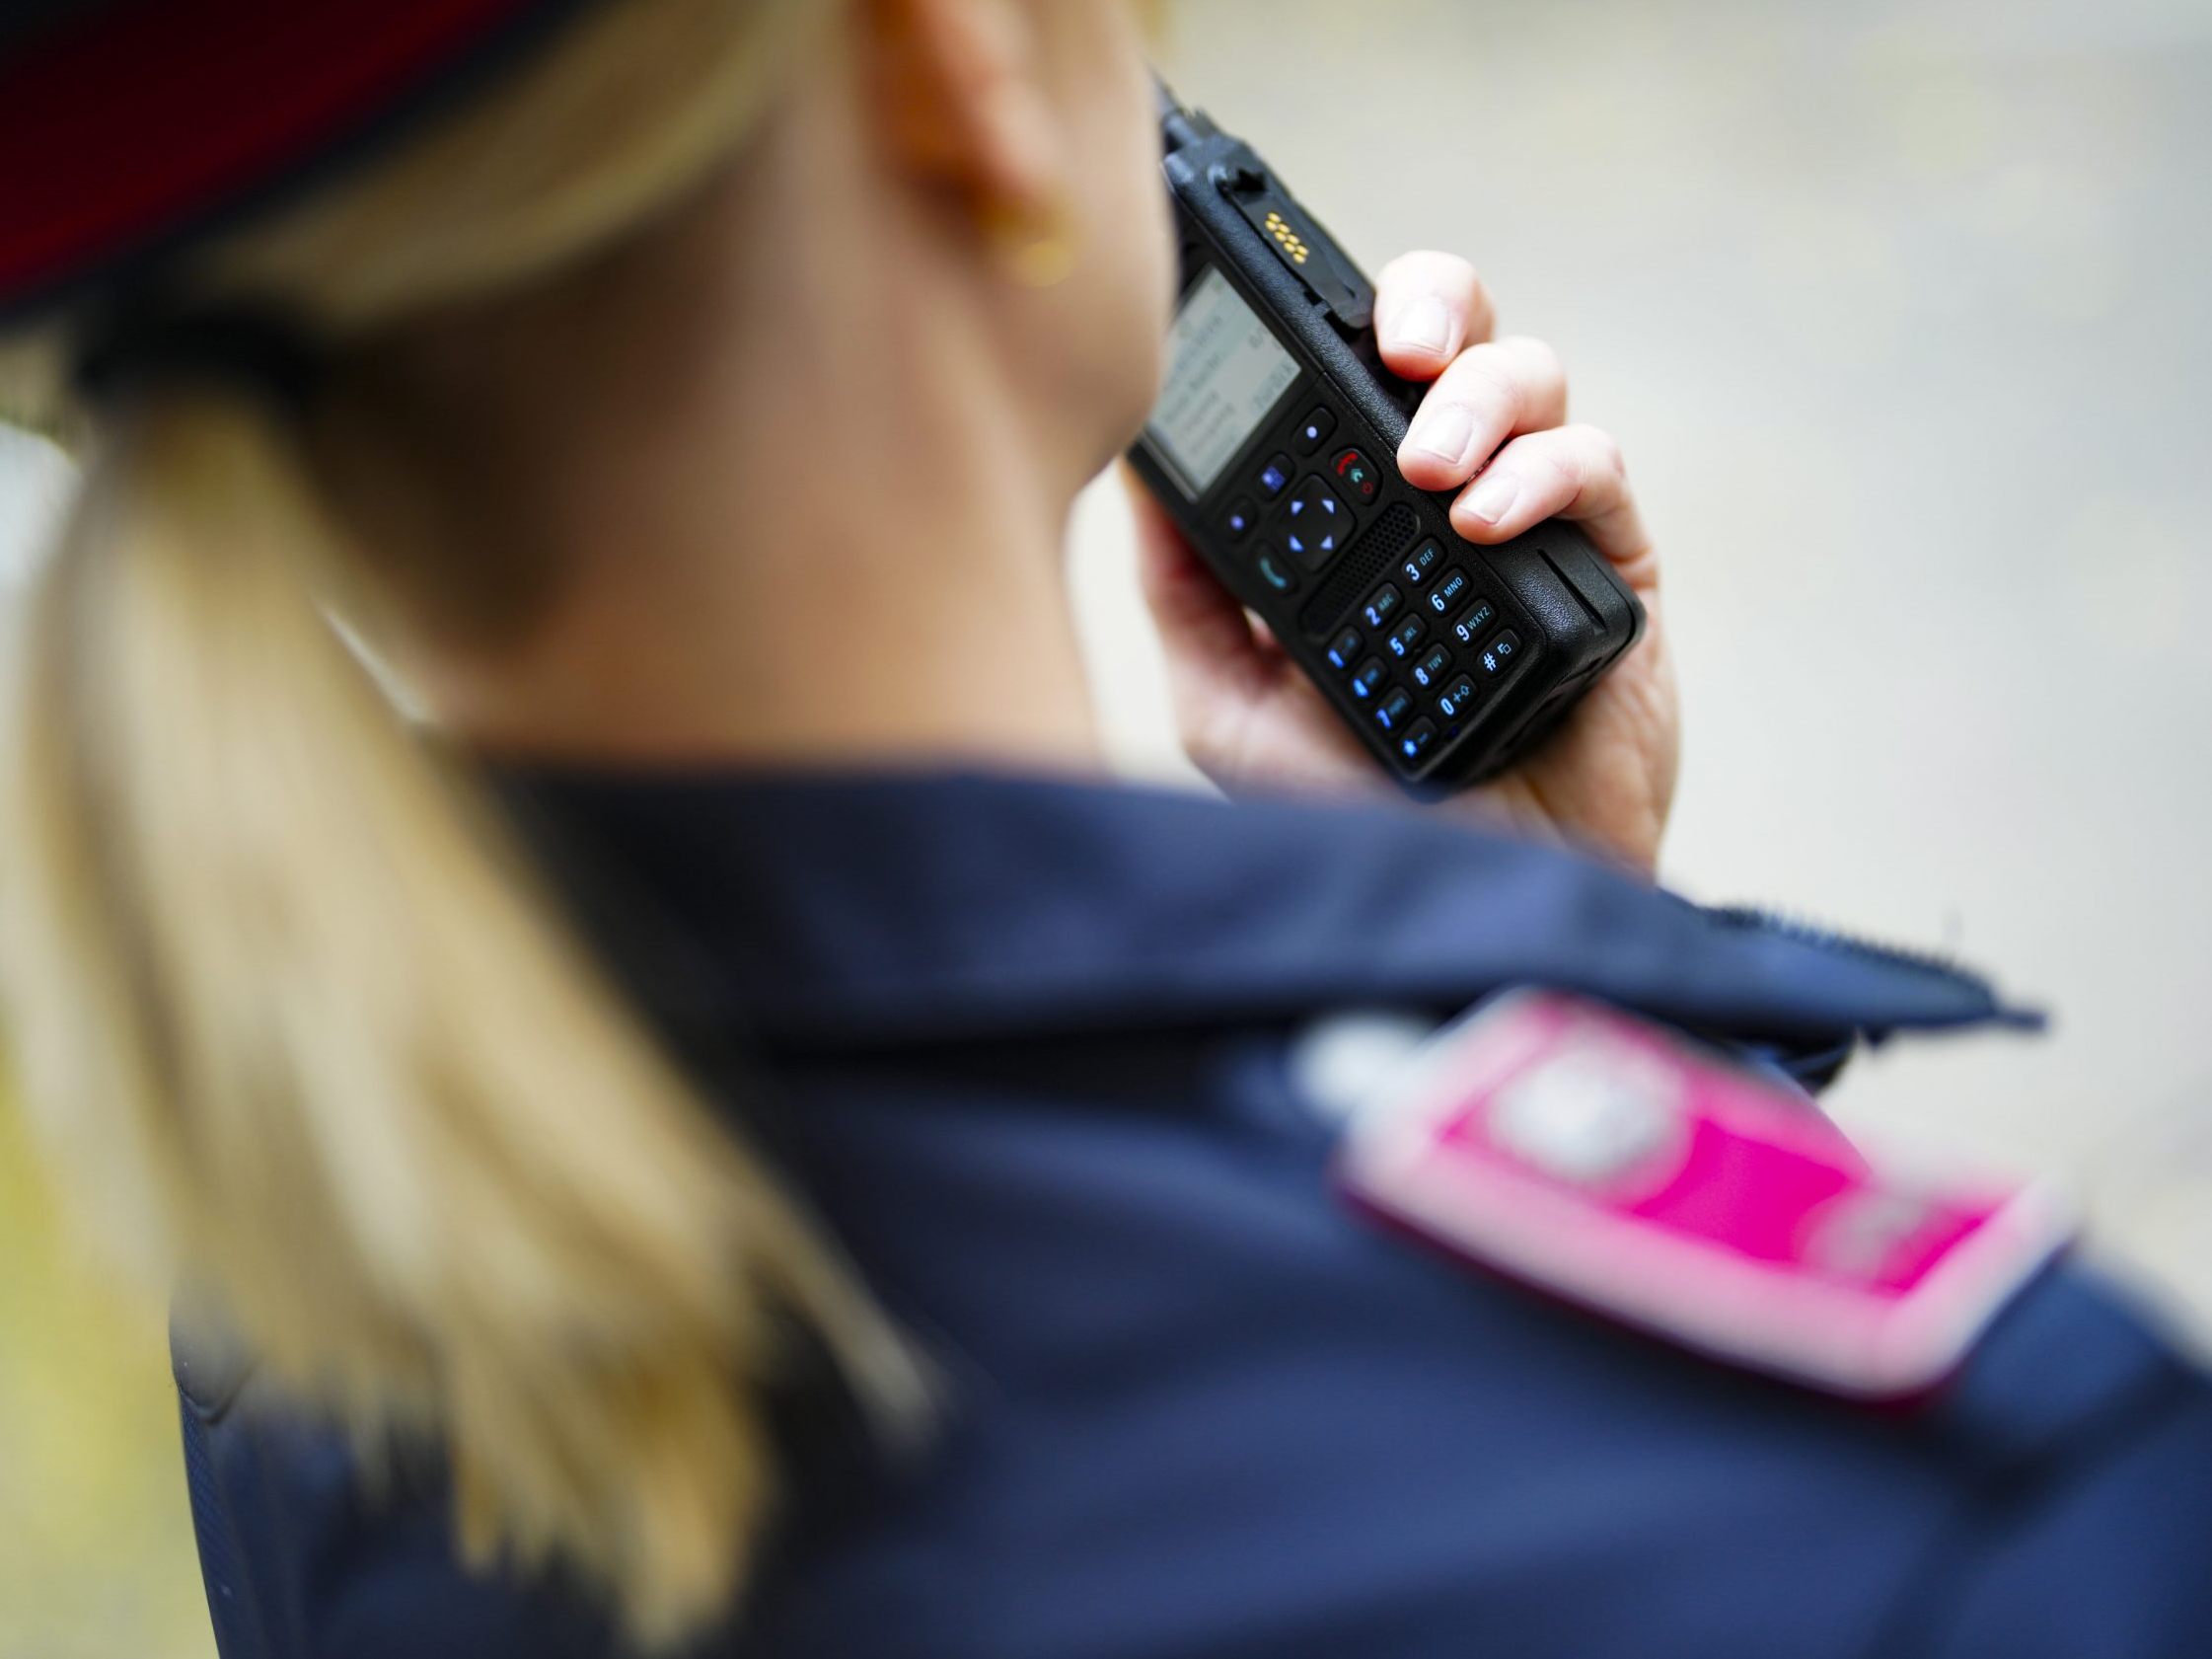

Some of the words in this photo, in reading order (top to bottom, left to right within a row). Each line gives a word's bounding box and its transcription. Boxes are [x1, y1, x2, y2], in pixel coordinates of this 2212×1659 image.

[1406, 563, 1420, 581] 3
[1419, 548, 1435, 566] DEF
[1431, 593, 1445, 611] 6
[1443, 576, 1463, 598] MNO
[1364, 606, 1381, 626] 2
[1456, 624, 1470, 641] 9
[1466, 606, 1490, 631] WXYZ
[1389, 637, 1405, 656] 5
[1415, 667, 1430, 685] 8
